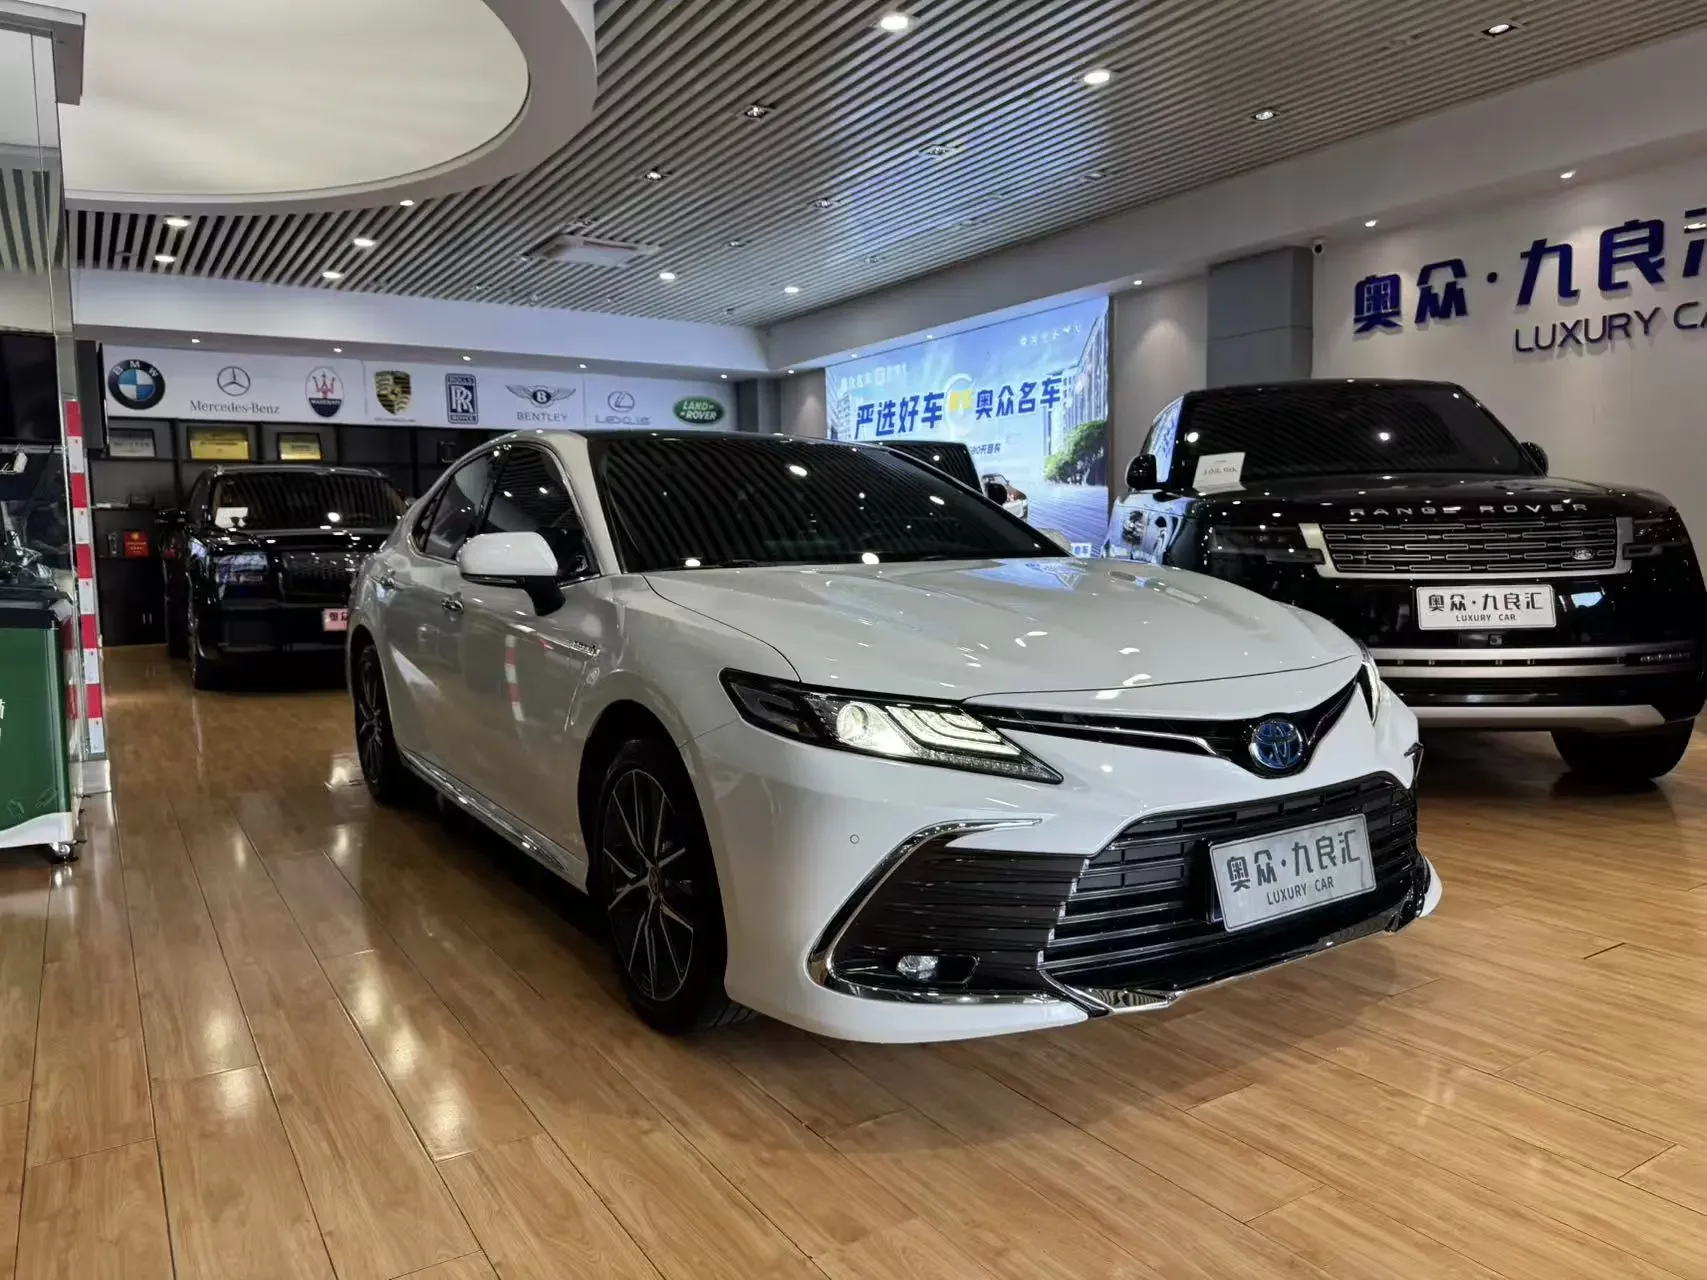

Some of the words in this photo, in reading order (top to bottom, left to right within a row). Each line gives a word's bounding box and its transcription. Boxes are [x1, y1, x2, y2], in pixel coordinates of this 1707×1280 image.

[1514, 306, 1661, 352] LUXURY
[1673, 301, 1707, 330] C
[112, 361, 159, 377] BMW
[190, 400, 281, 414] Mercedes-Benz
[855, 392, 945, 440] 严选好车
[976, 378, 1062, 421] 奥众名车
[516, 411, 568, 422] BENTLEY
[1349, 506, 1462, 516] RANGE
[1479, 503, 1587, 514] ROVER
[1456, 614, 1492, 622] LUXURY
[1498, 613, 1516, 621] CAR
[1266, 883, 1307, 905] LUXURY
[1314, 876, 1334, 892] CAR
